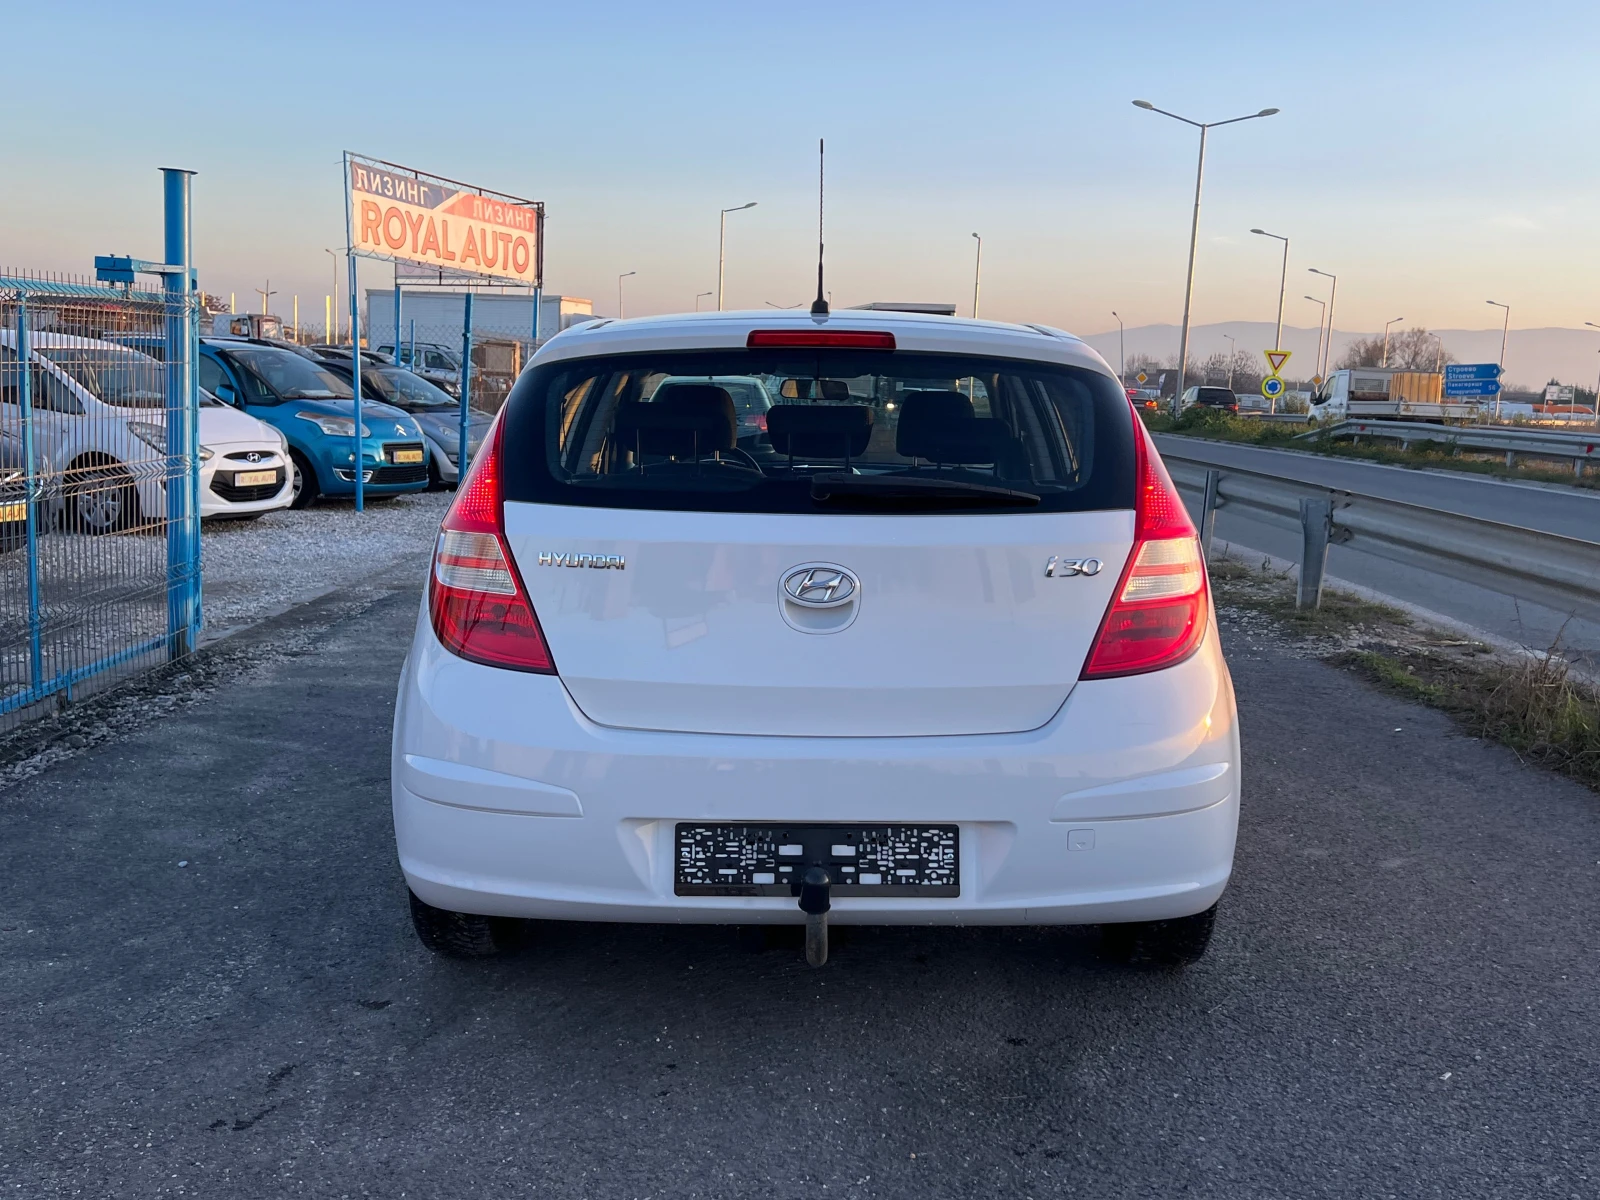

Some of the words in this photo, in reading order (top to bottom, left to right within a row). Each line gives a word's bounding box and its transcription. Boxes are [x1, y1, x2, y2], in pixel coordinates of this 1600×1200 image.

[357, 168, 428, 205] ЛИЗИНГ
[473, 201, 532, 230] ЛИЗИНГ
[361, 200, 456, 261] ROYAL
[460, 225, 529, 274] AUTO
[7, 506, 26, 518] AUT
[538, 551, 625, 570] HYUNDAI
